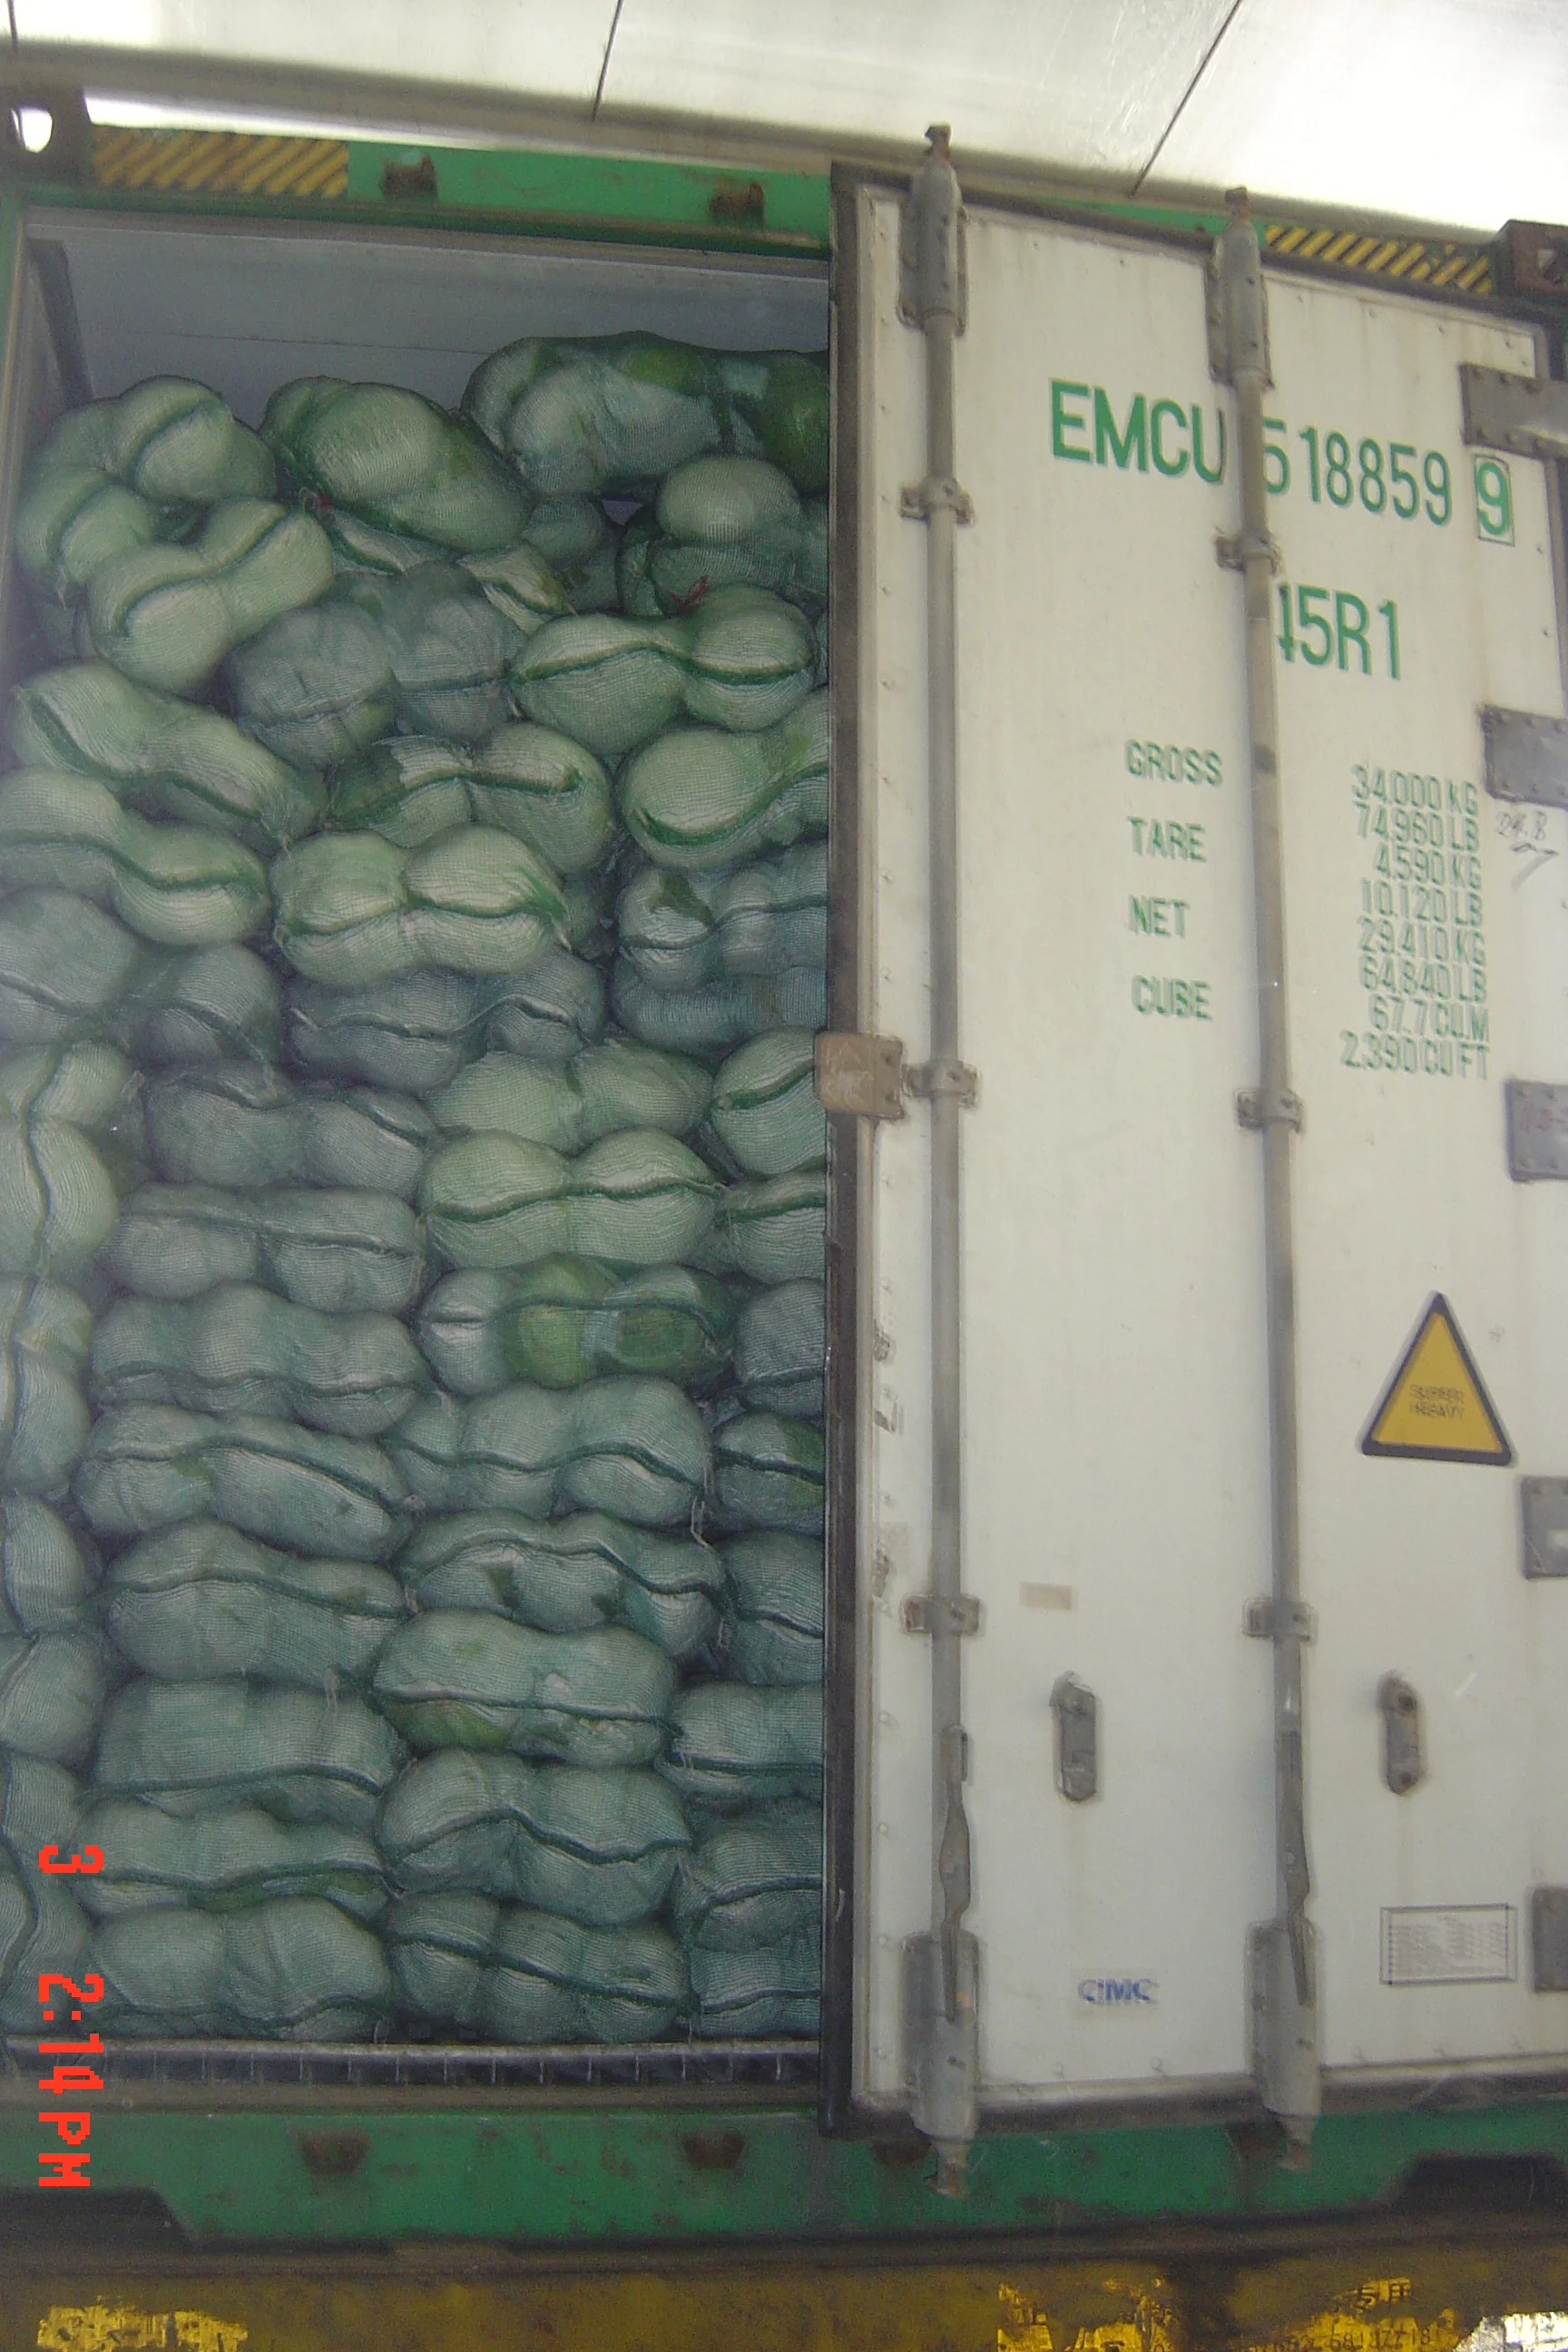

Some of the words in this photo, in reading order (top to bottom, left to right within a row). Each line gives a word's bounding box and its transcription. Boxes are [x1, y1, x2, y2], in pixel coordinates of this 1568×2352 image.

[1051, 378, 1226, 484] EMCU
[1263, 418, 1451, 526] 518859
[1473, 460, 1512, 536] 9
[1125, 739, 1223, 787] GROSS
[1445, 778, 1479, 816] KG
[1127, 816, 1207, 863] TARE
[1448, 815, 1480, 853] LB
[1450, 851, 1483, 891] KG
[1128, 895, 1190, 938] NET
[1450, 889, 1485, 926] LB
[1453, 927, 1485, 966] KG
[1131, 975, 1212, 1021] CUBE
[1454, 963, 1488, 1003] LB
[1078, 1979, 1161, 2004] CIMC
